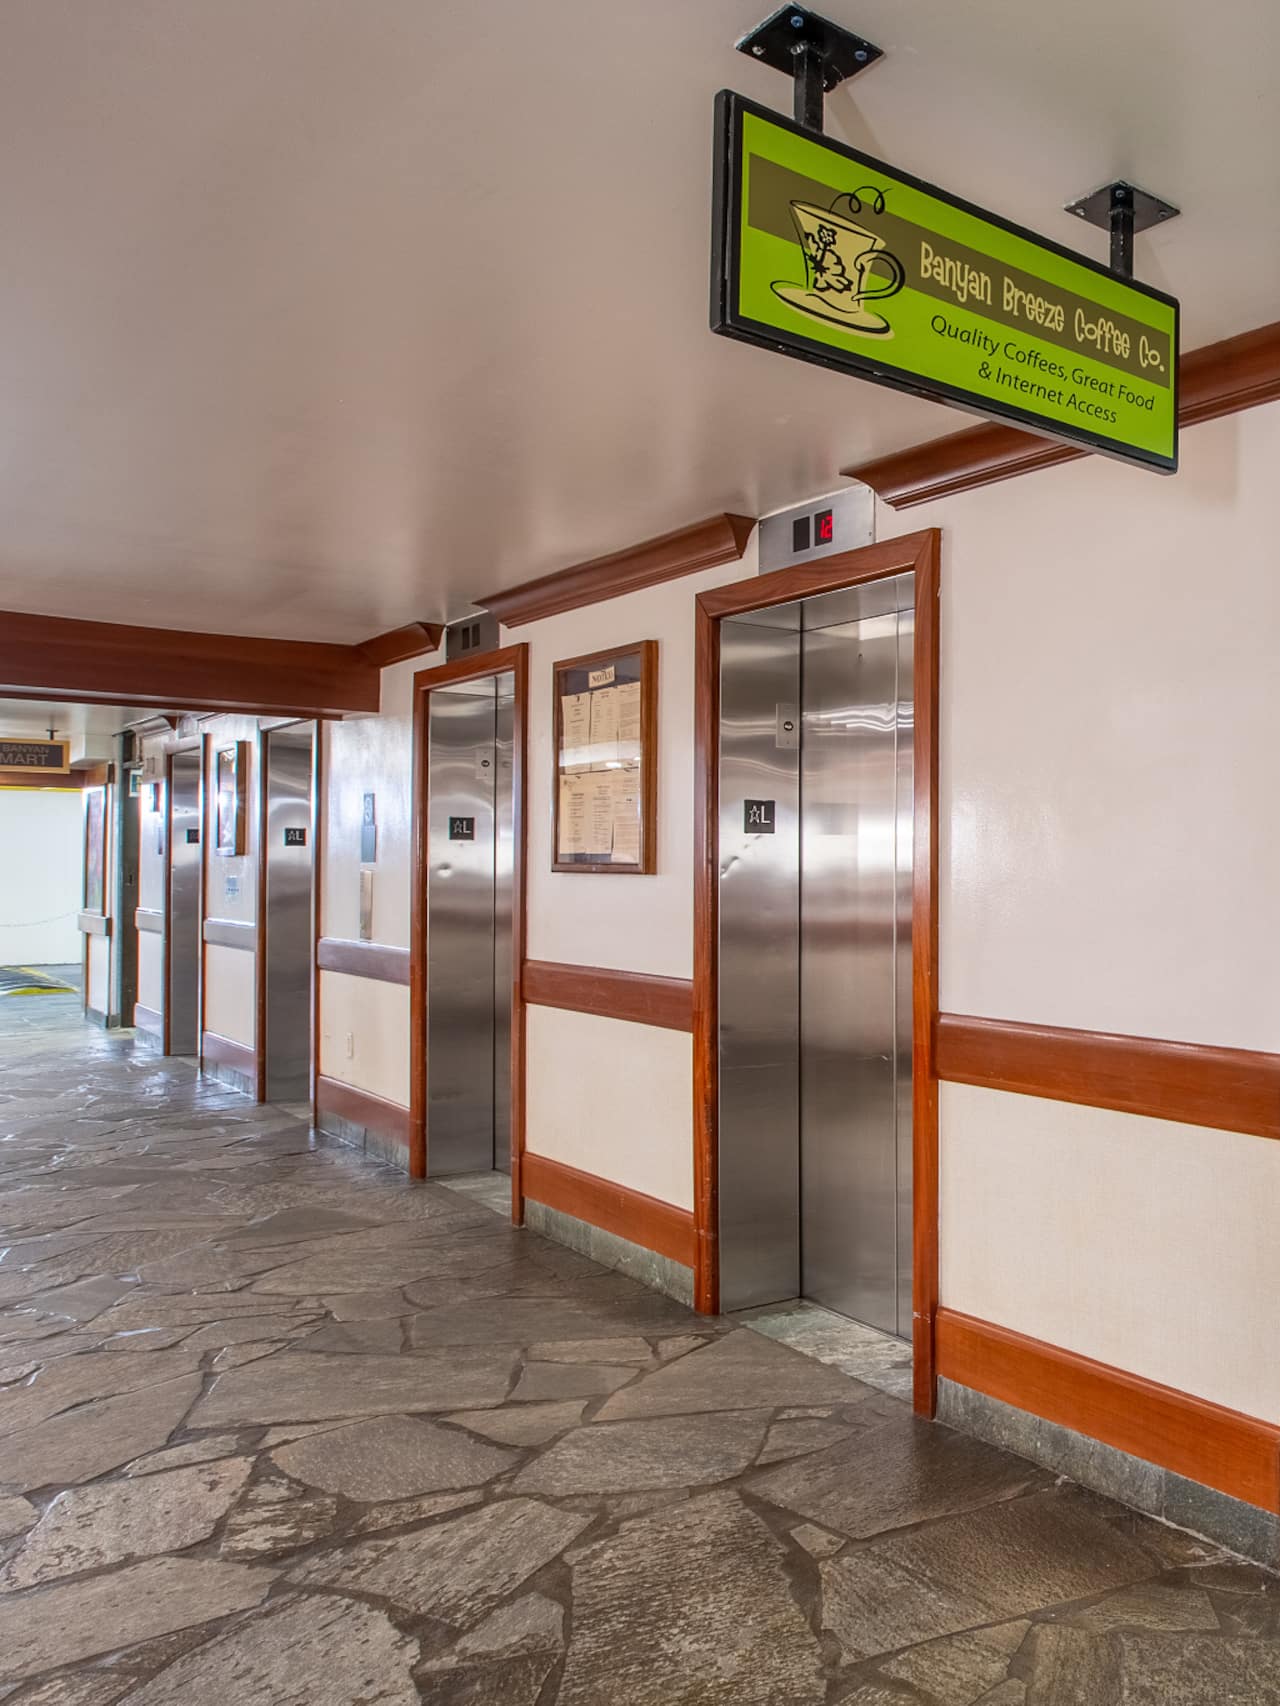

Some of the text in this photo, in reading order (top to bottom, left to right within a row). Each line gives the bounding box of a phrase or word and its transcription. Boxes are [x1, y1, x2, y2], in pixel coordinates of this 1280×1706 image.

[921, 241, 1165, 372] Banyan Breeze Coffee Co.
[931, 314, 1155, 411] Quality Coffees, Great Food
[978, 361, 1117, 424] & Internet Access
[0, 752, 48, 766] MART
